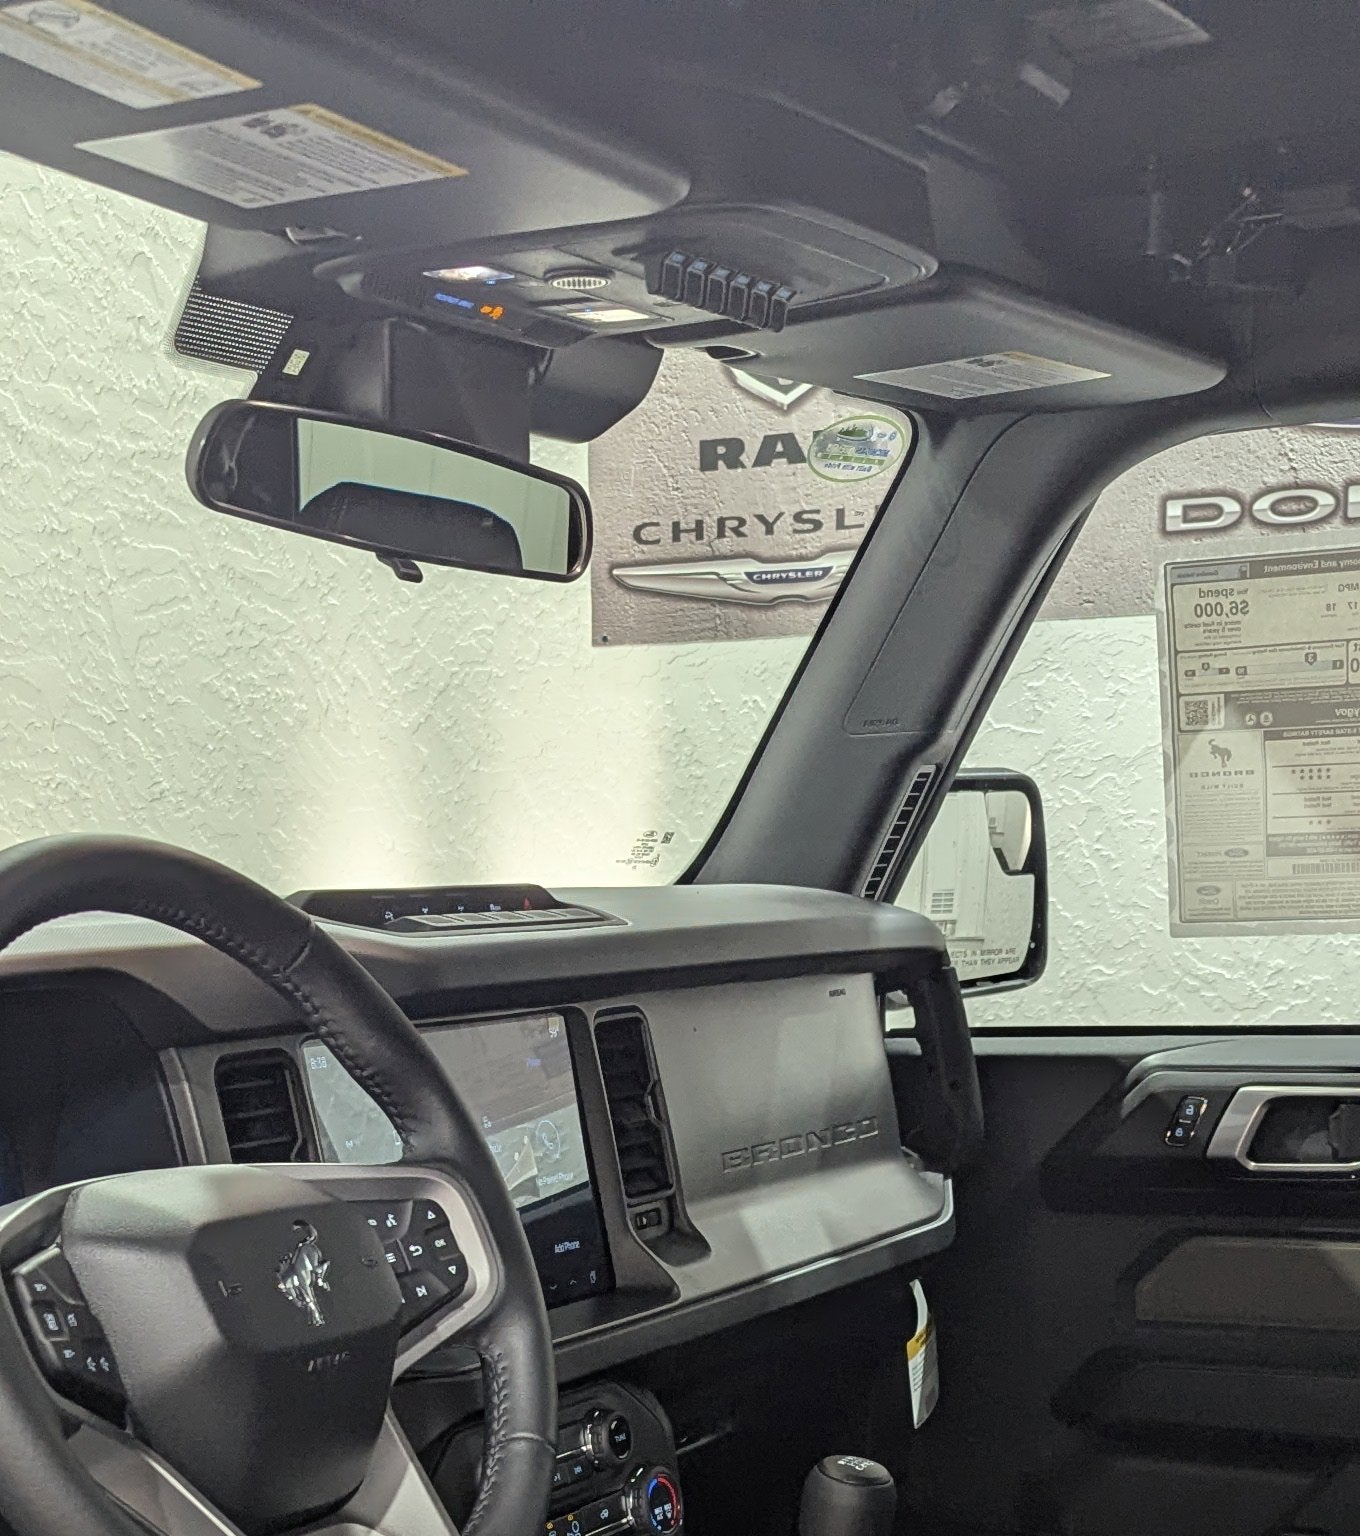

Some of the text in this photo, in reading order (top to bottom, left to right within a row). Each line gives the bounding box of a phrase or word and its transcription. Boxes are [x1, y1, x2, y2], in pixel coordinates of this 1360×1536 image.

[633, 506, 880, 546] CHRYSL
[752, 568, 824, 581] CHRYSLER
[720, 1116, 879, 1175] BRONCO
